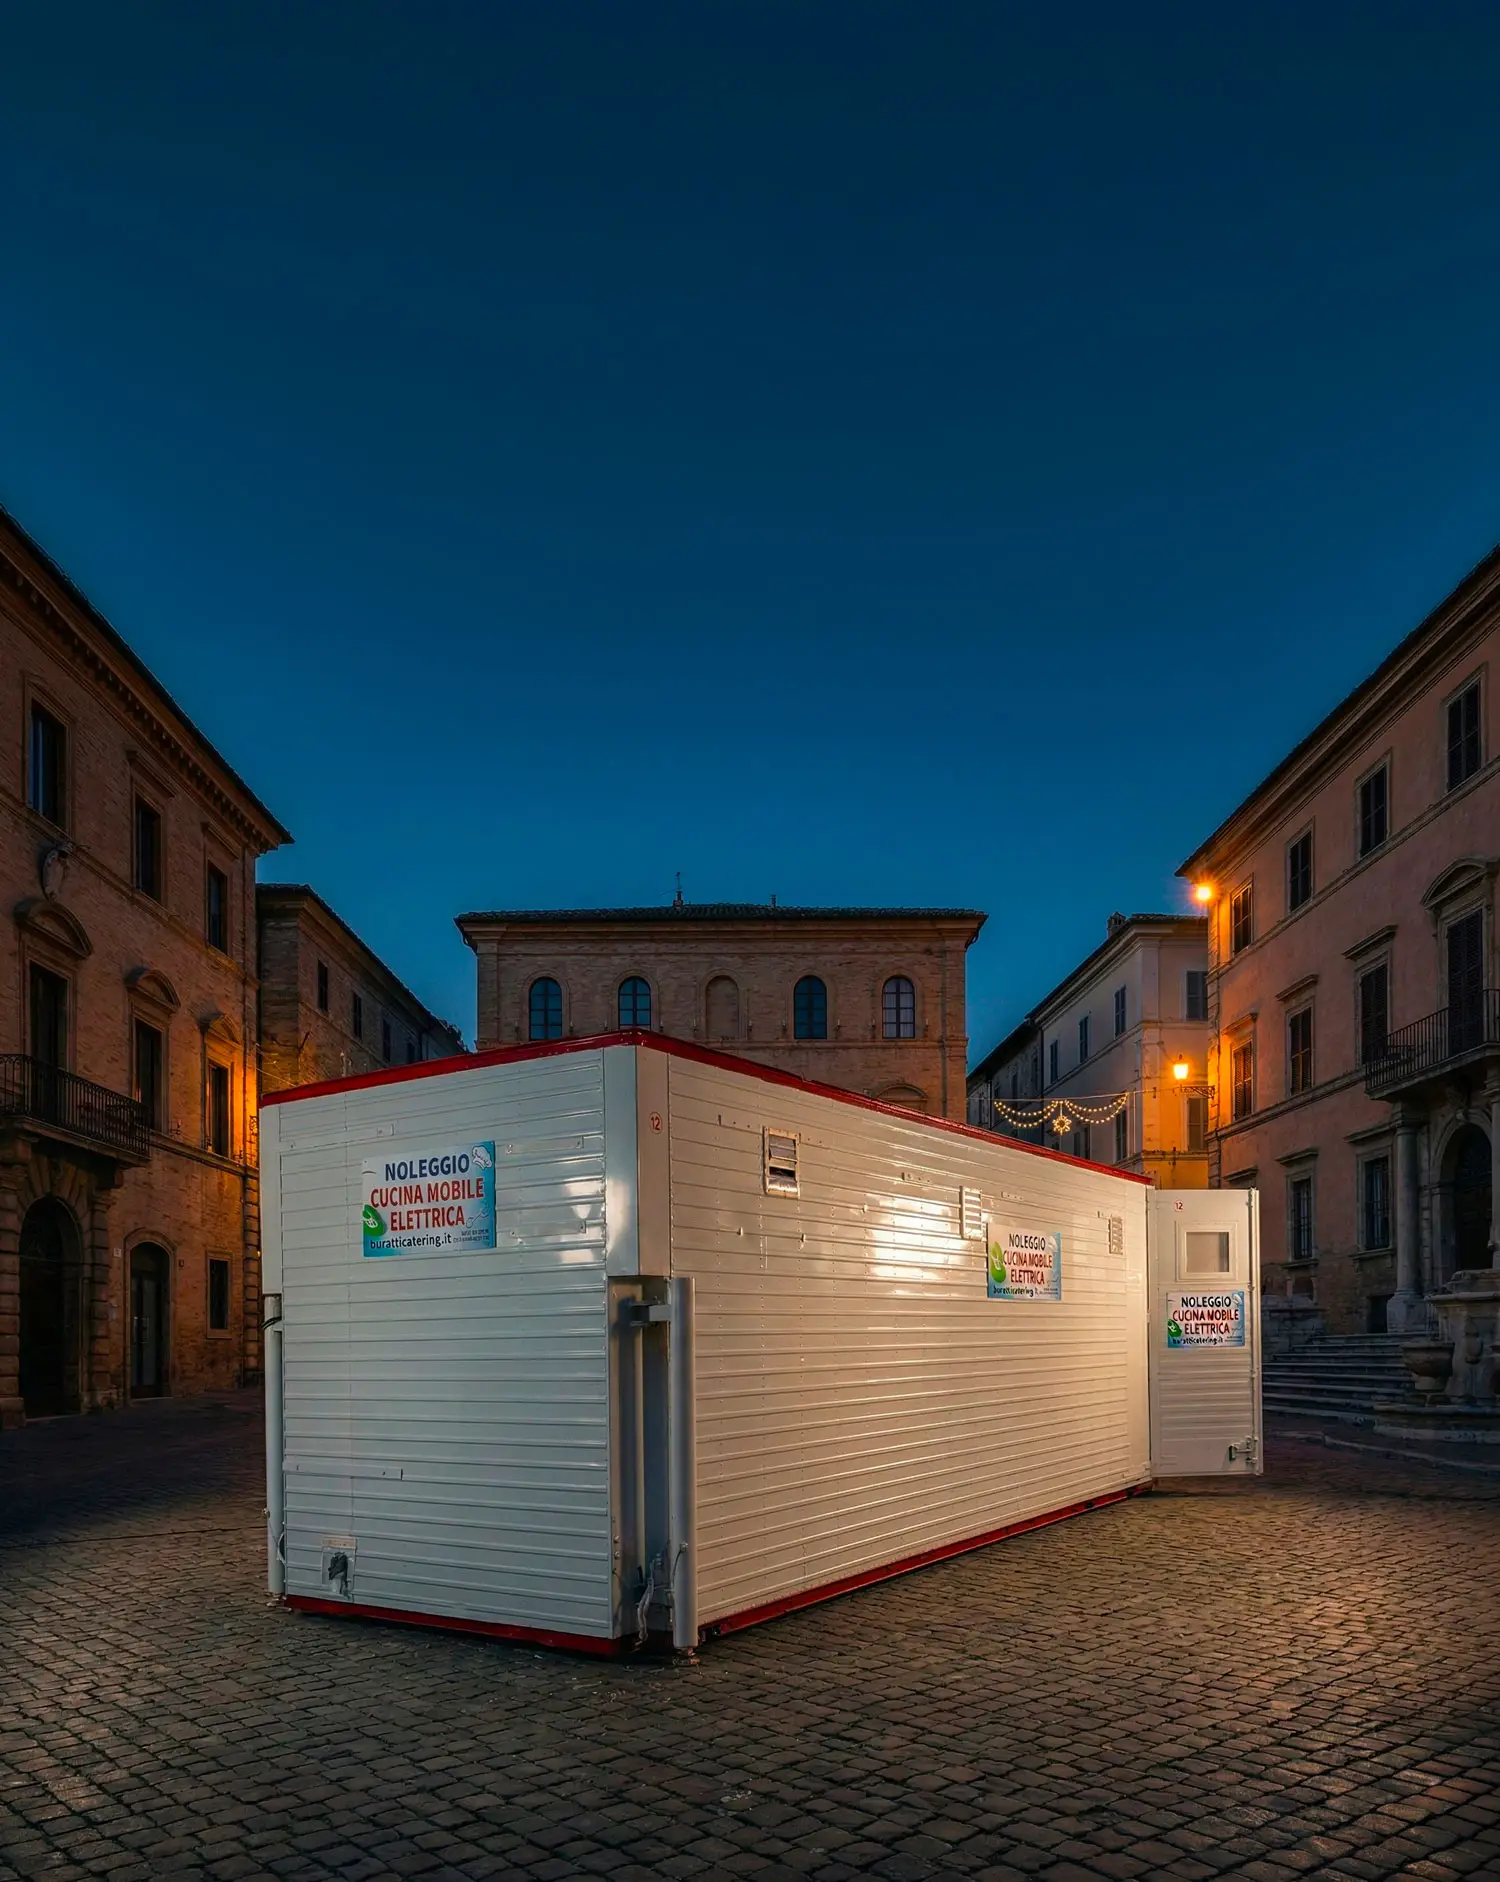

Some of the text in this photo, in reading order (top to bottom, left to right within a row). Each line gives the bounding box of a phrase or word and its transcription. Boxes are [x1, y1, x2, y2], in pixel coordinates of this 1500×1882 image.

[650, 1116, 661, 1131] 12
[385, 1154, 470, 1181] NOLEGGIO
[370, 1178, 485, 1208] CUCINA MOBILE
[390, 1205, 466, 1232] ELETTRICA
[370, 1232, 452, 1249] buratticatering.it
[1009, 1233, 1046, 1250] NOLEGGIO
[1003, 1250, 1053, 1269] CUCINA MOBILE
[1010, 1269, 1045, 1285] ELETTRICA
[1181, 1296, 1232, 1308] NOLEGGIO
[1172, 1308, 1239, 1322] CUCINA MOBILE
[1184, 1322, 1230, 1335] ELETTRICA
